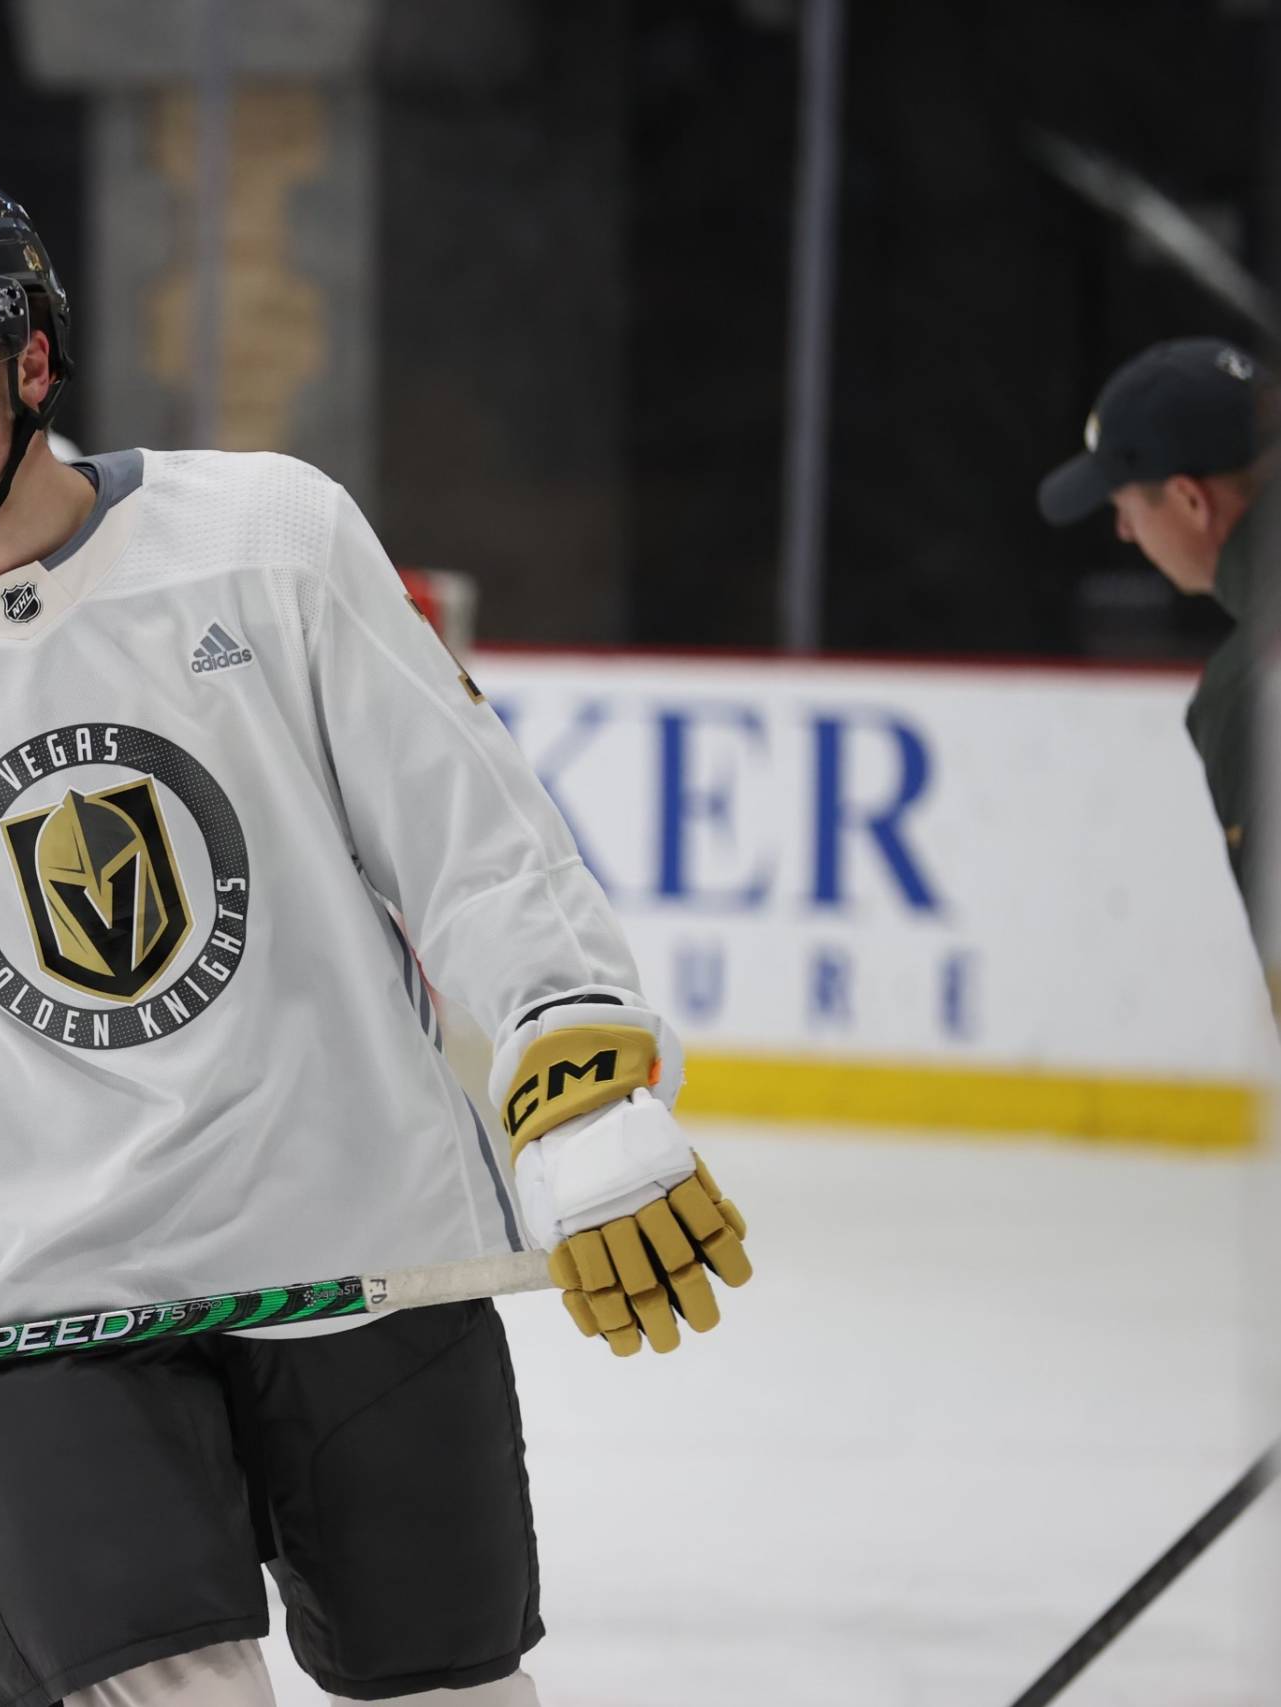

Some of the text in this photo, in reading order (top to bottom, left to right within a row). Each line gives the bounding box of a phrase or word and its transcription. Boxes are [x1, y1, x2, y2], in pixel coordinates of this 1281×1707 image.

[12, 591, 32, 618] NHL
[191, 648, 253, 674] adidas
[137, 877, 247, 1039] KNIGHTS
[503, 1049, 619, 1137] CM
[137, 1304, 188, 1326] FT5
